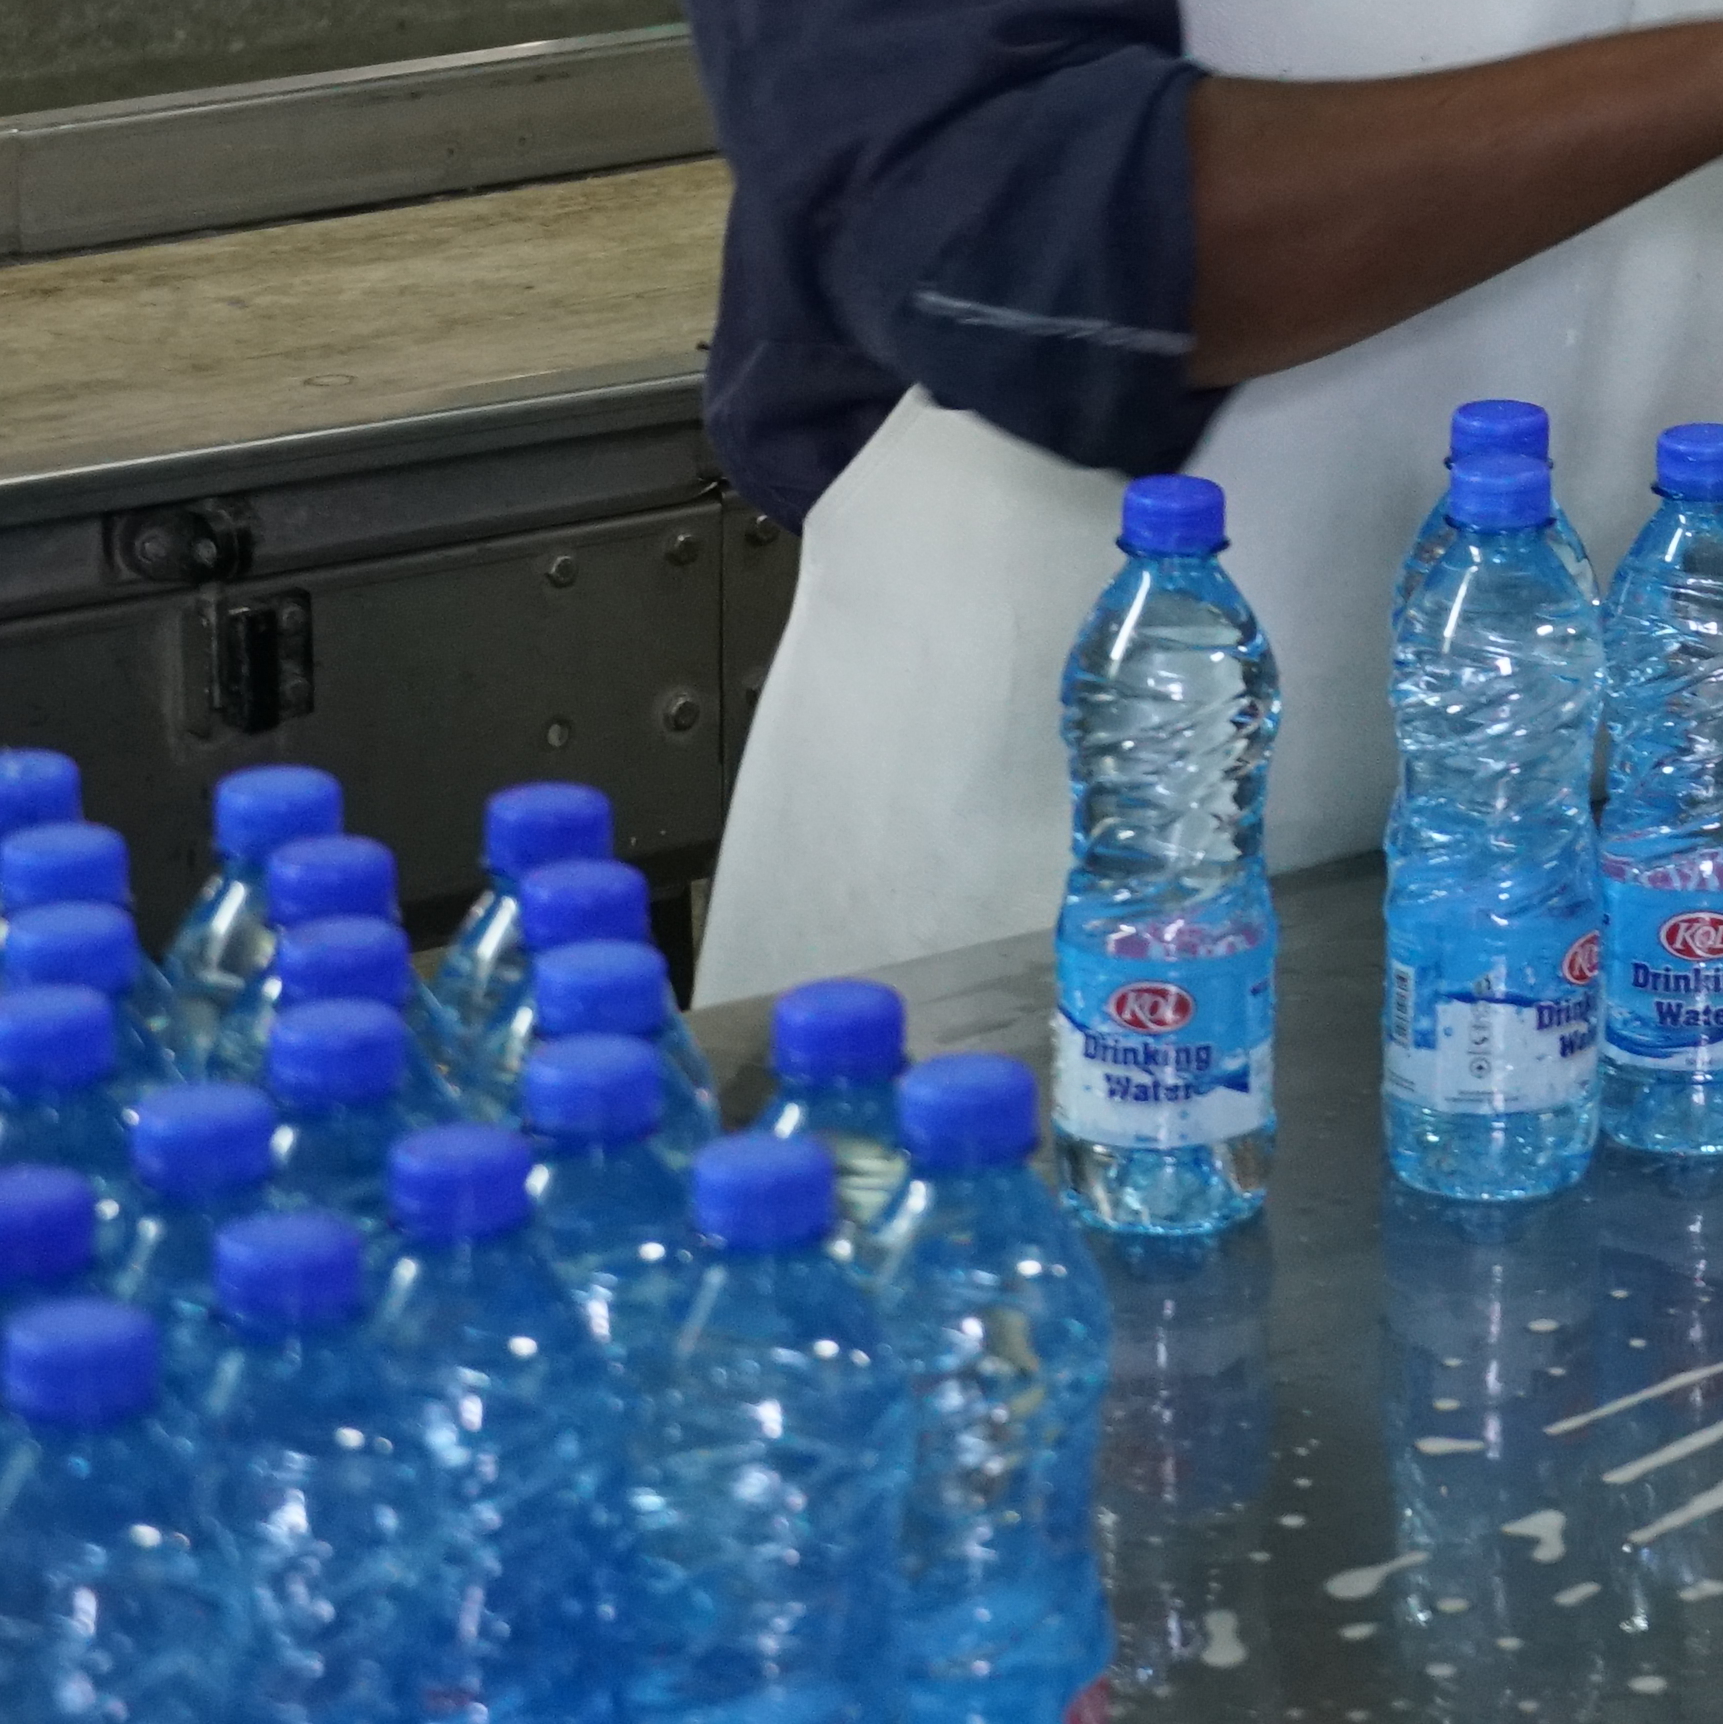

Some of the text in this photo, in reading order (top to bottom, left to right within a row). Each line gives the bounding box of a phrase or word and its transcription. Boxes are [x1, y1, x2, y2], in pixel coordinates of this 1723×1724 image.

[1120, 990, 1181, 1028] KOL
[1083, 1032, 1212, 1072] Drinking
[1103, 1073, 1194, 1103] Water
